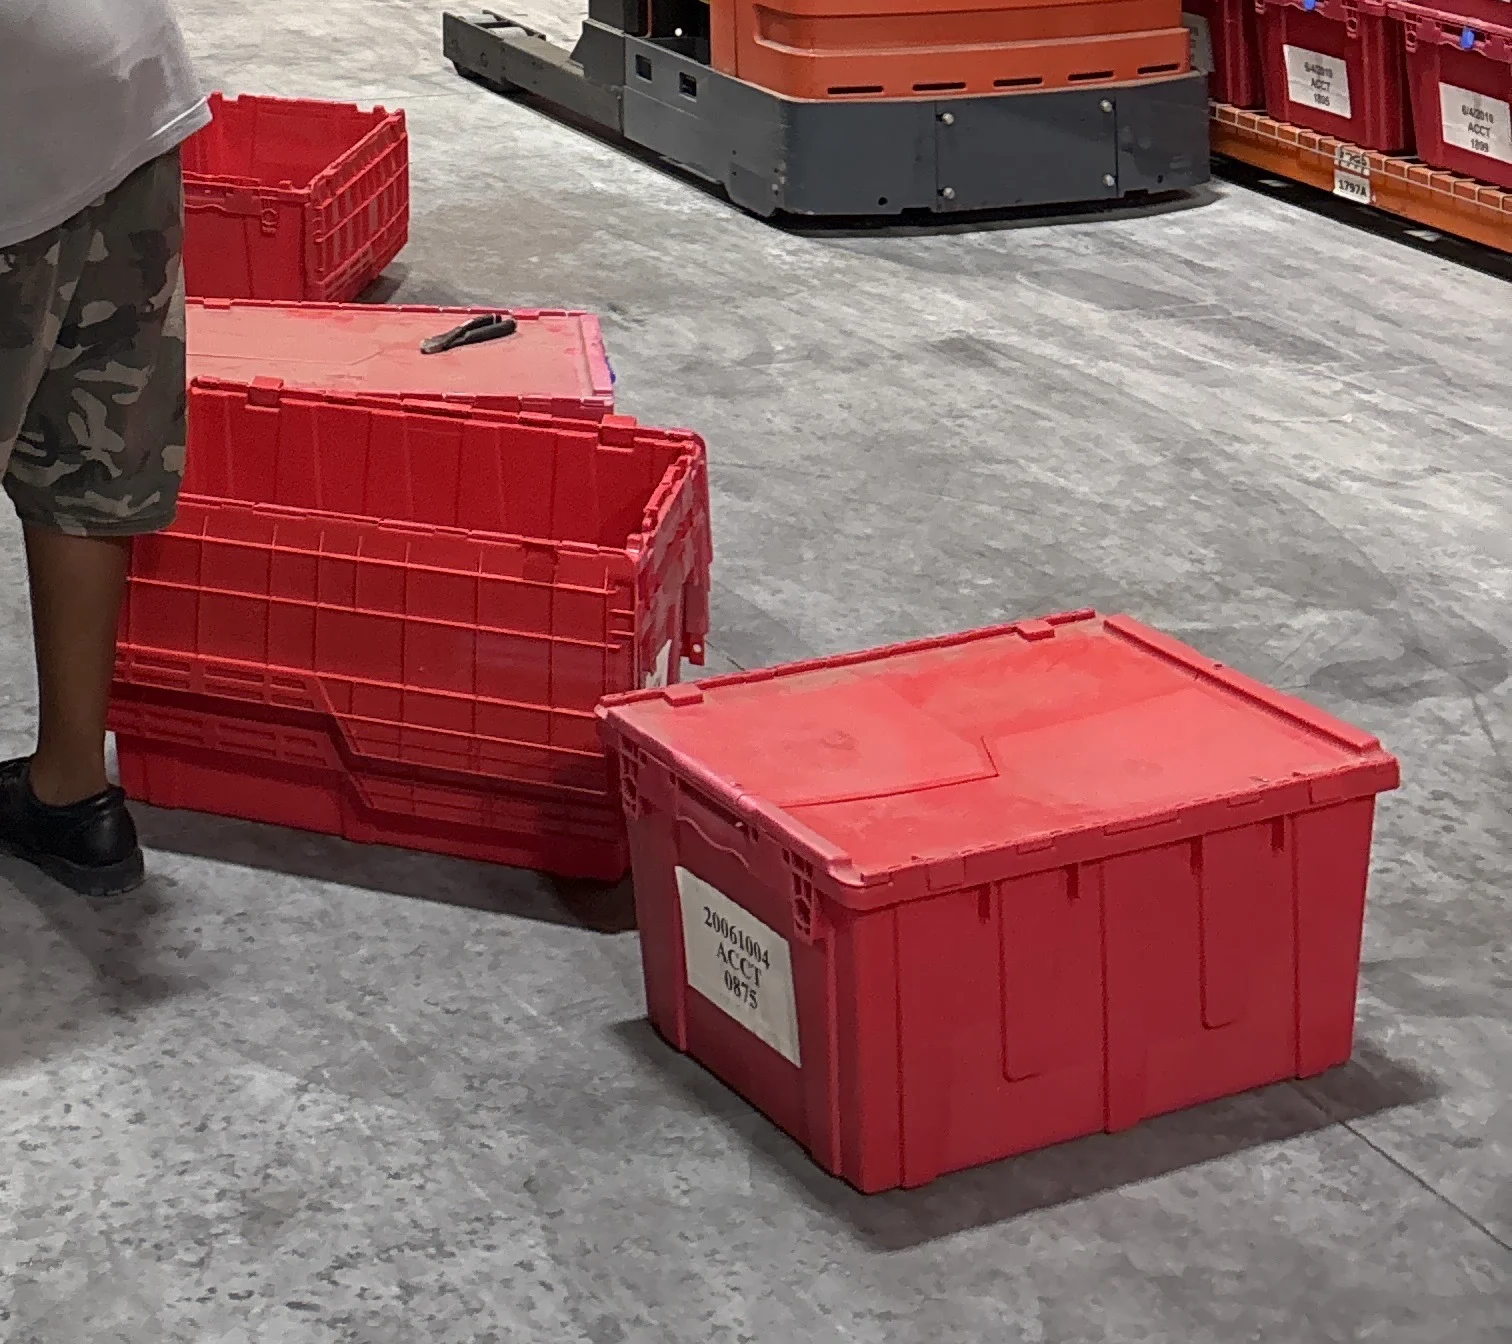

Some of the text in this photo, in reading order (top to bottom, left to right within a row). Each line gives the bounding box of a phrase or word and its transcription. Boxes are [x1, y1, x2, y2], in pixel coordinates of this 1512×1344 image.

[1311, 78, 1331, 92] ACCT
[1467, 122, 1491, 137] ACCT
[1338, 179, 1367, 196] 1797A
[703, 906, 771, 971] 20061004
[716, 941, 762, 988] ACCT
[724, 969, 758, 1010] 0875
